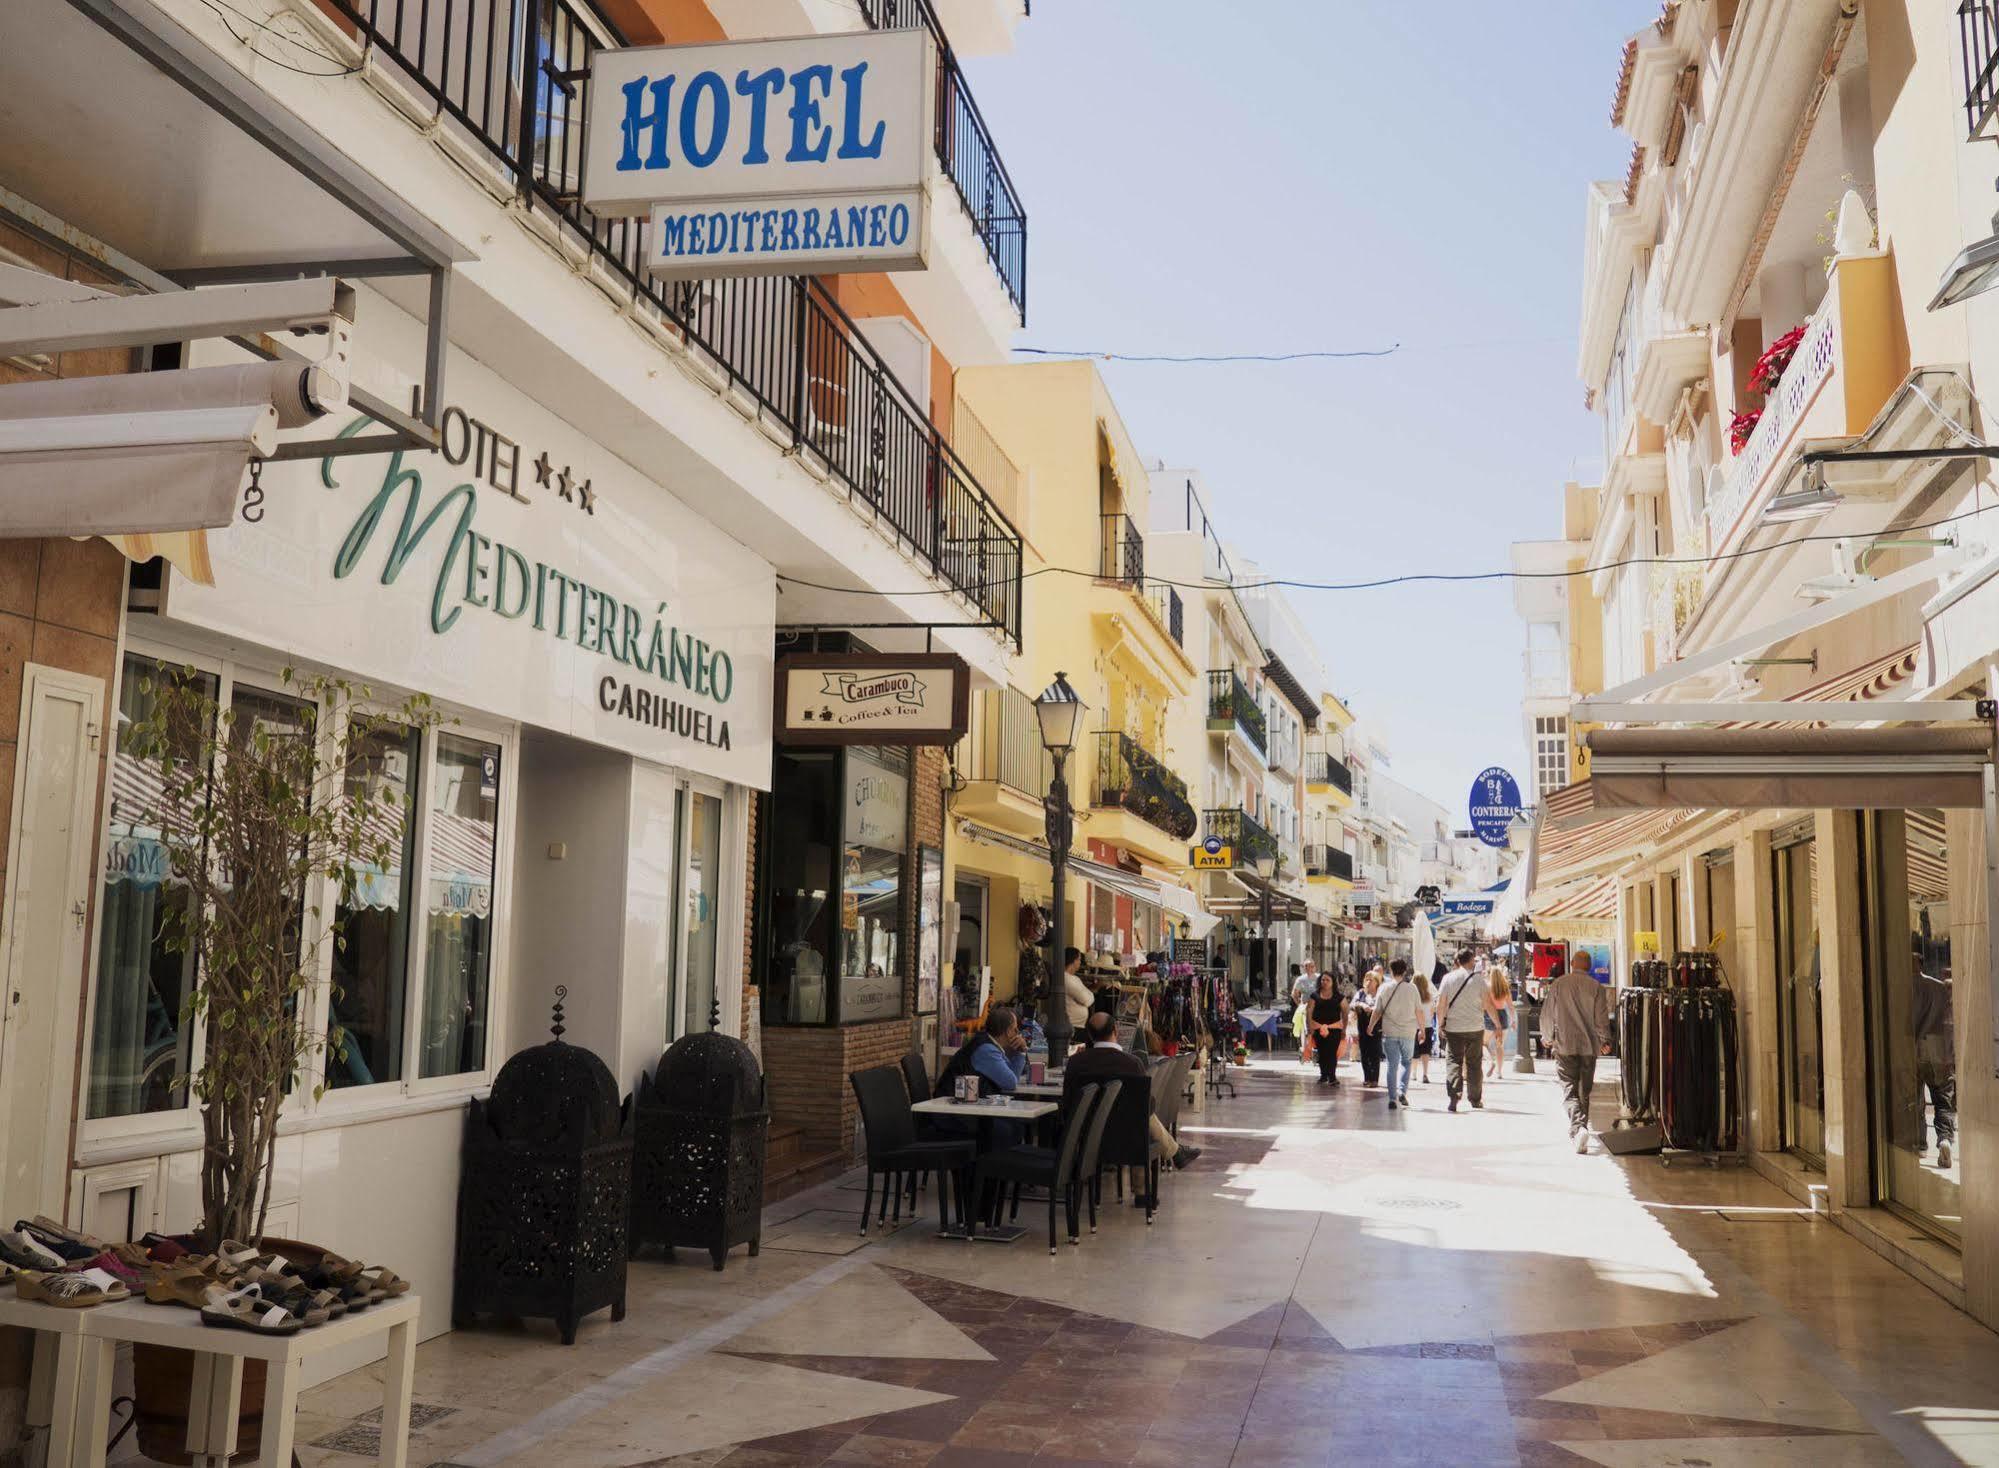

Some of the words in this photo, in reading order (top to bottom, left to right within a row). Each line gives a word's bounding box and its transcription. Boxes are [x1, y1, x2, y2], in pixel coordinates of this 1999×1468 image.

[616, 60, 886, 172] HOTEL
[662, 202, 910, 257] MEDITERRANEO
[846, 678, 909, 701] Carambuco
[600, 674, 731, 752] CARIHUELA
[838, 709, 881, 725] Coffee
[894, 704, 918, 715] Tea
[1478, 768, 1512, 783] BODEGA
[1200, 857, 1226, 866] ATM
[1455, 902, 1488, 912] Bodega
